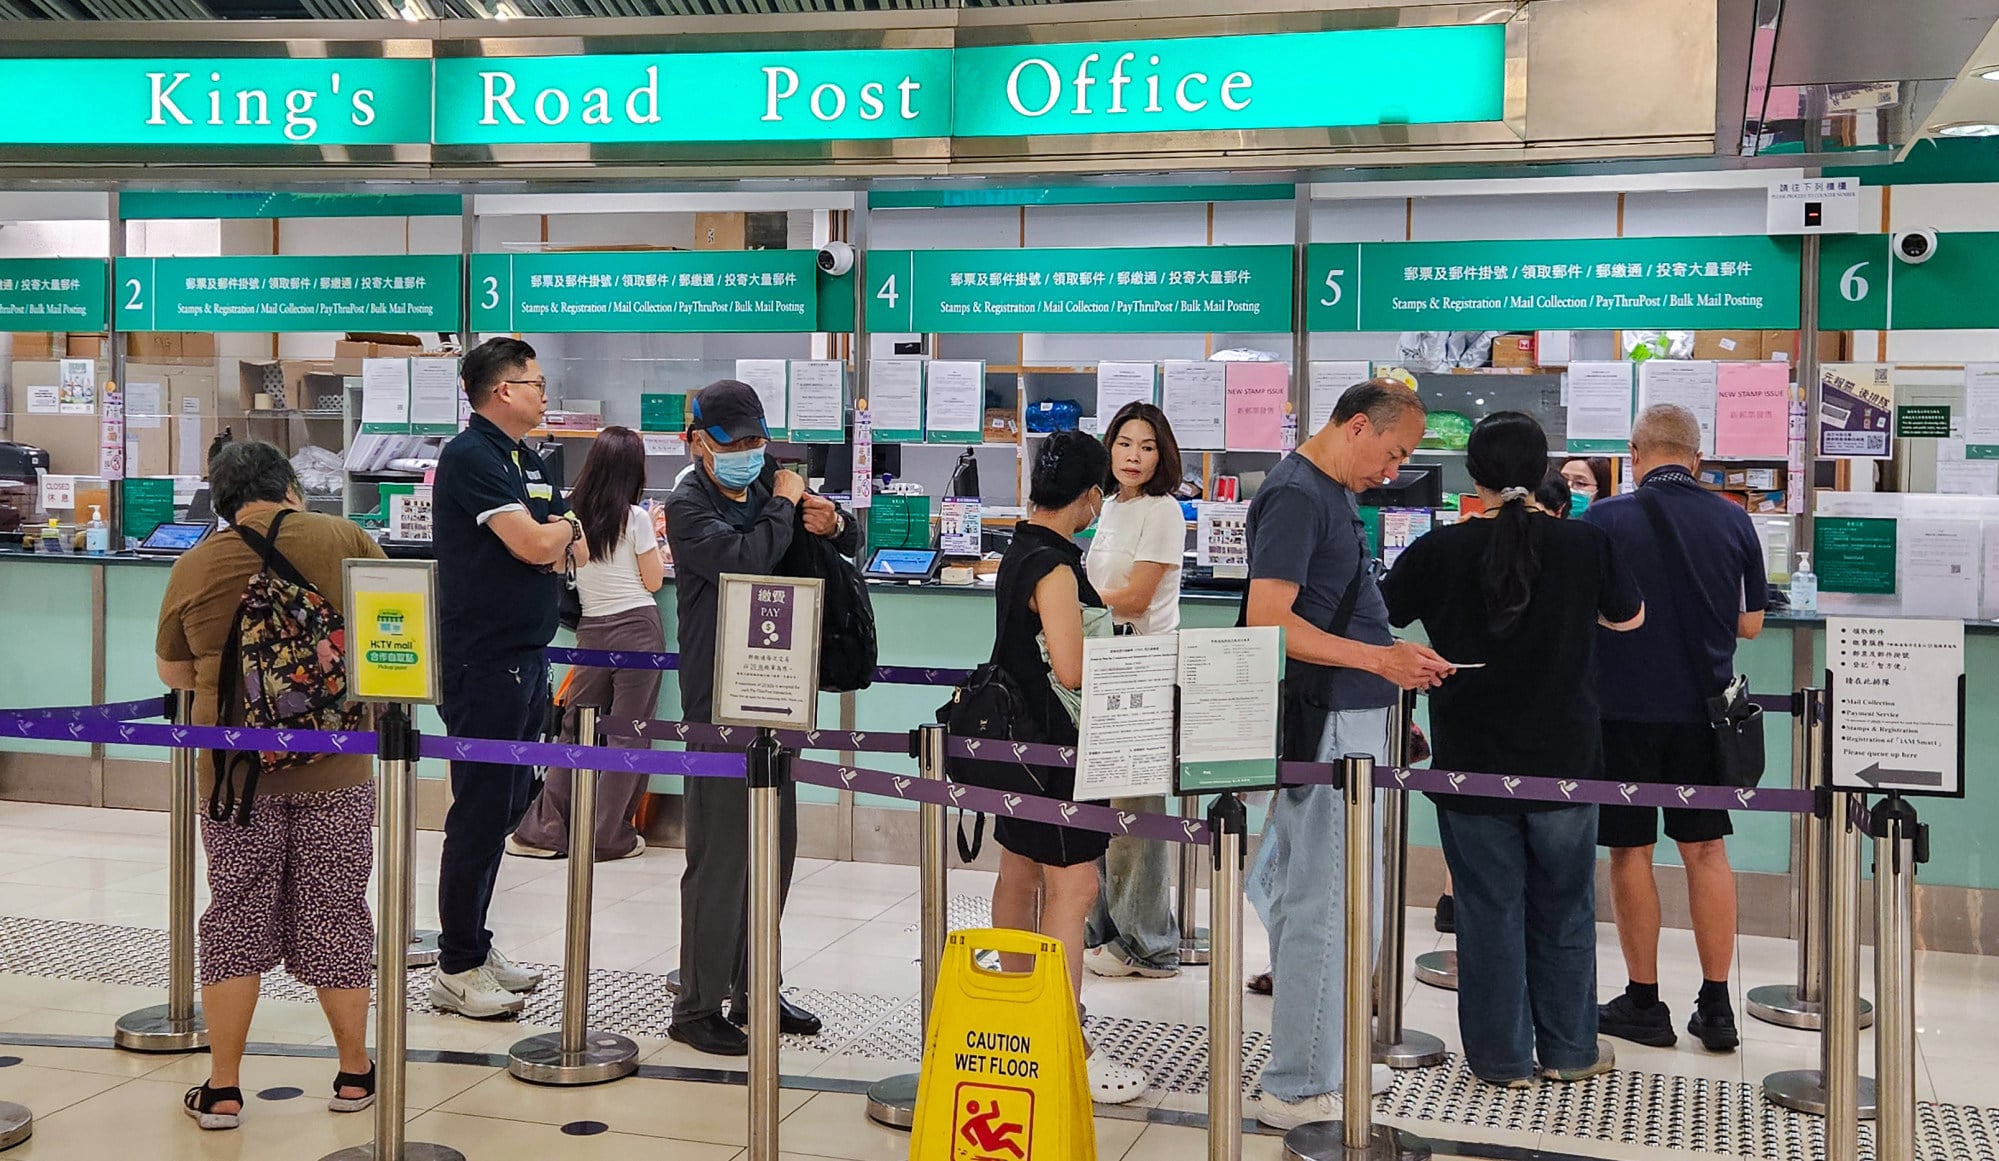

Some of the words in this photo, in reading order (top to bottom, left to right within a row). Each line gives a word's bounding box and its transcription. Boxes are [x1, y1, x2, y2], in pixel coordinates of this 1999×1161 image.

[145, 72, 376, 140] King's
[478, 64, 662, 125] Road
[760, 66, 921, 122] Post
[1006, 51, 1254, 117] Office
[950, 272, 1041, 286] 郵票及郵件掛號
[1052, 272, 1106, 286] 領取郵件
[1117, 271, 1157, 285] 郵繳通
[1169, 270, 1251, 285] 投寄大量郵件
[1404, 265, 1508, 281] 郵票及郵件掛號
[1521, 264, 1583, 279] 領取郵件
[1595, 263, 1642, 278] 郵繳通
[1656, 261, 1752, 278] 投寄大量郵件
[1320, 269, 1345, 306] 5
[1840, 261, 1869, 302] 6
[125, 278, 144, 310] 2
[481, 276, 500, 309] 3
[876, 274, 899, 308] 4
[30, 303, 45, 314] Bulk
[46, 303, 61, 314] Mail
[63, 303, 87, 317] Posting
[177, 303, 203, 316] Stamps
[204, 303, 212, 314] &
[214, 303, 254, 316] Registration
[261, 303, 277, 314] Mail
[278, 303, 314, 314] Collection
[320, 303, 364, 316] PayThruPost
[370, 303, 387, 314] Bulk
[389, 303, 406, 314] Mail
[408, 303, 433, 316] Posting
[521, 302, 549, 315] Stamps
[550, 302, 558, 313] &
[560, 301, 607, 315] Registration
[613, 301, 631, 312] Mail
[633, 301, 672, 312] Collection
[679, 300, 728, 315] PayThruPost
[735, 300, 752, 312] Bulk
[755, 300, 774, 312] Mail
[776, 300, 804, 314] Posting
[941, 301, 970, 315] Stamps
[973, 301, 981, 313] &
[984, 301, 1035, 315] Registration
[1043, 300, 1063, 312] Mail
[1065, 300, 1109, 312] Collection
[1117, 300, 1173, 315] PayThruPost
[1181, 299, 1201, 312] Bulk
[1204, 299, 1225, 311] Mail
[1227, 299, 1260, 314] Posting
[1393, 297, 1427, 312] Stamps
[1429, 297, 1440, 309] &
[1443, 297, 1501, 312] Registration
[1510, 295, 1534, 308] Mail
[1536, 295, 1587, 308] Collection
[1596, 294, 1661, 310] PayThruPost
[1669, 293, 1694, 307] Bulk
[1697, 293, 1721, 306] Mail
[1724, 293, 1763, 309] Posting
[46, 482, 70, 490] CLOSED
[758, 588, 786, 604] 繳費
[760, 607, 781, 617] PAY
[1862, 699, 1895, 707] Collection
[1847, 710, 1875, 718] Payment
[1879, 726, 1919, 734] Registration
[1847, 736, 1886, 744] Registration
[966, 1030, 1031, 1054] CAUTION
[955, 1053, 986, 1073] WET
[989, 1057, 1039, 1079] FLOOR
